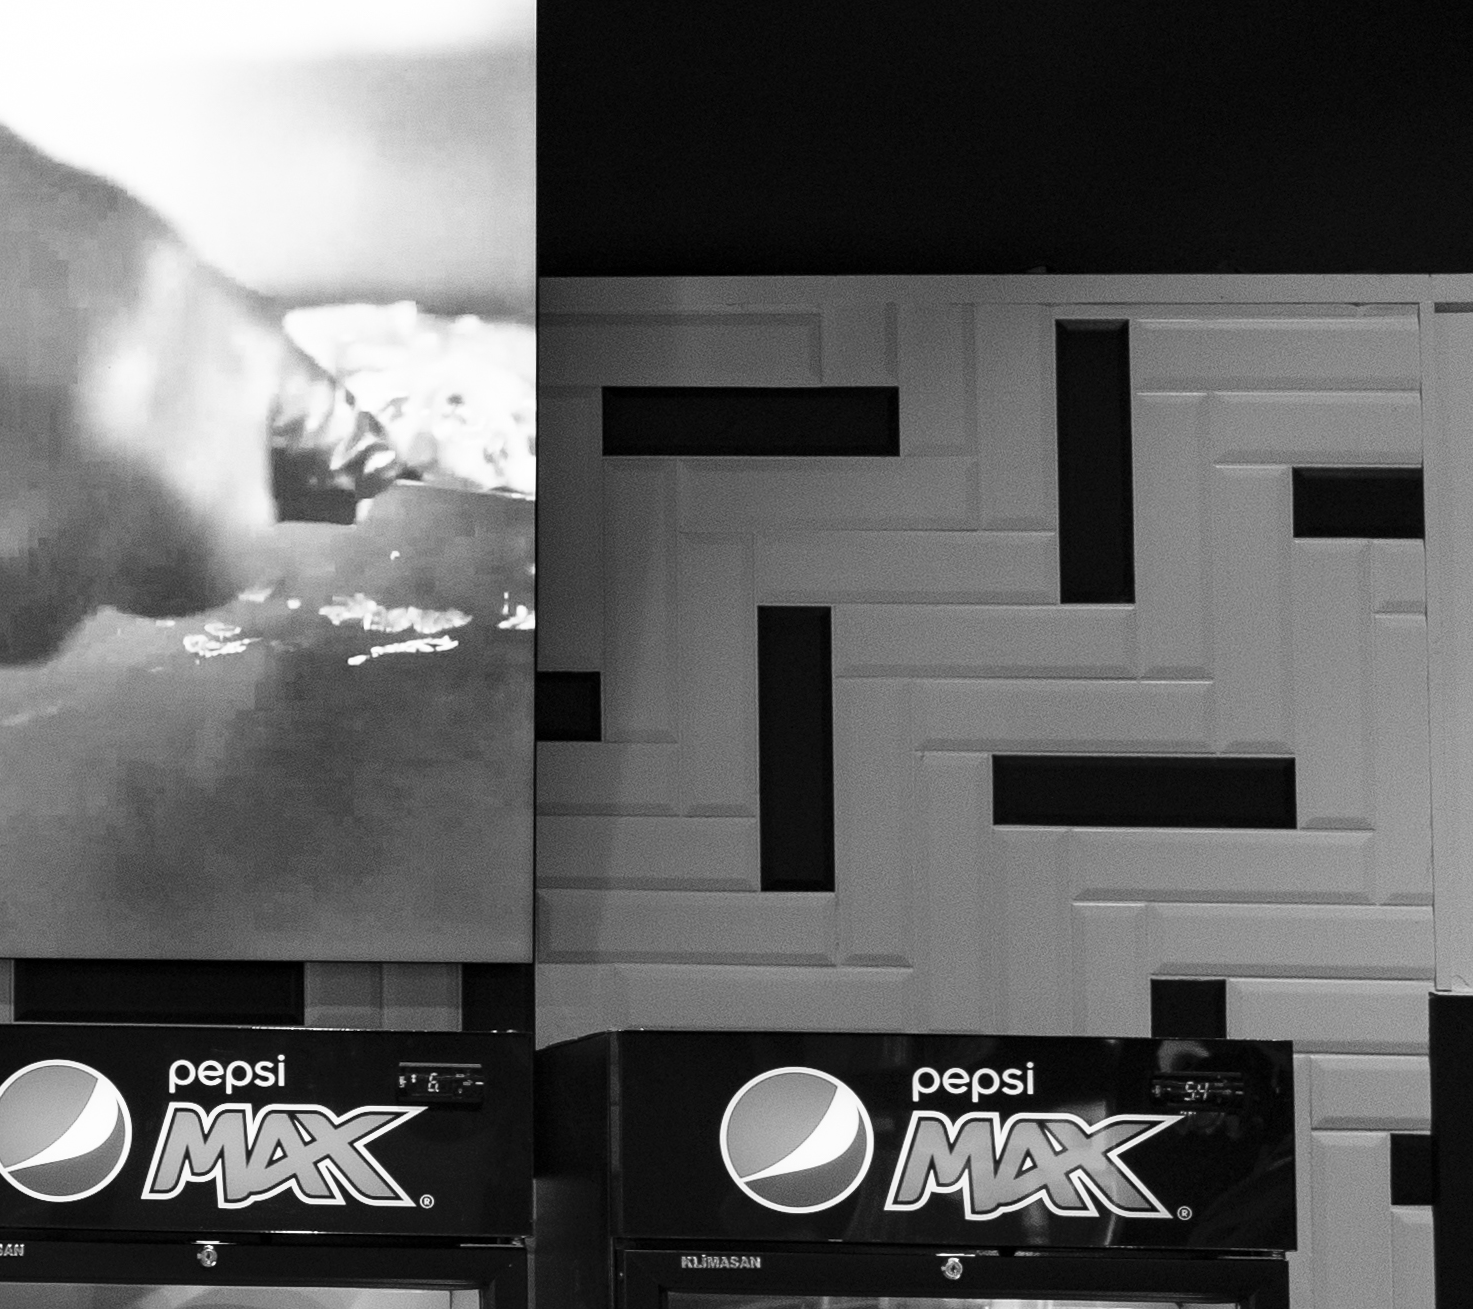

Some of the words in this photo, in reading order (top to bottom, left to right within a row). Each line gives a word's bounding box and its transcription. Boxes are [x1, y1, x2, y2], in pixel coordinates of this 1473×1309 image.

[168, 1054, 286, 1095] pepsi
[911, 1061, 1035, 1103] pepsi
[140, 1101, 429, 1209] MAX
[884, 1110, 1186, 1221] MAX
